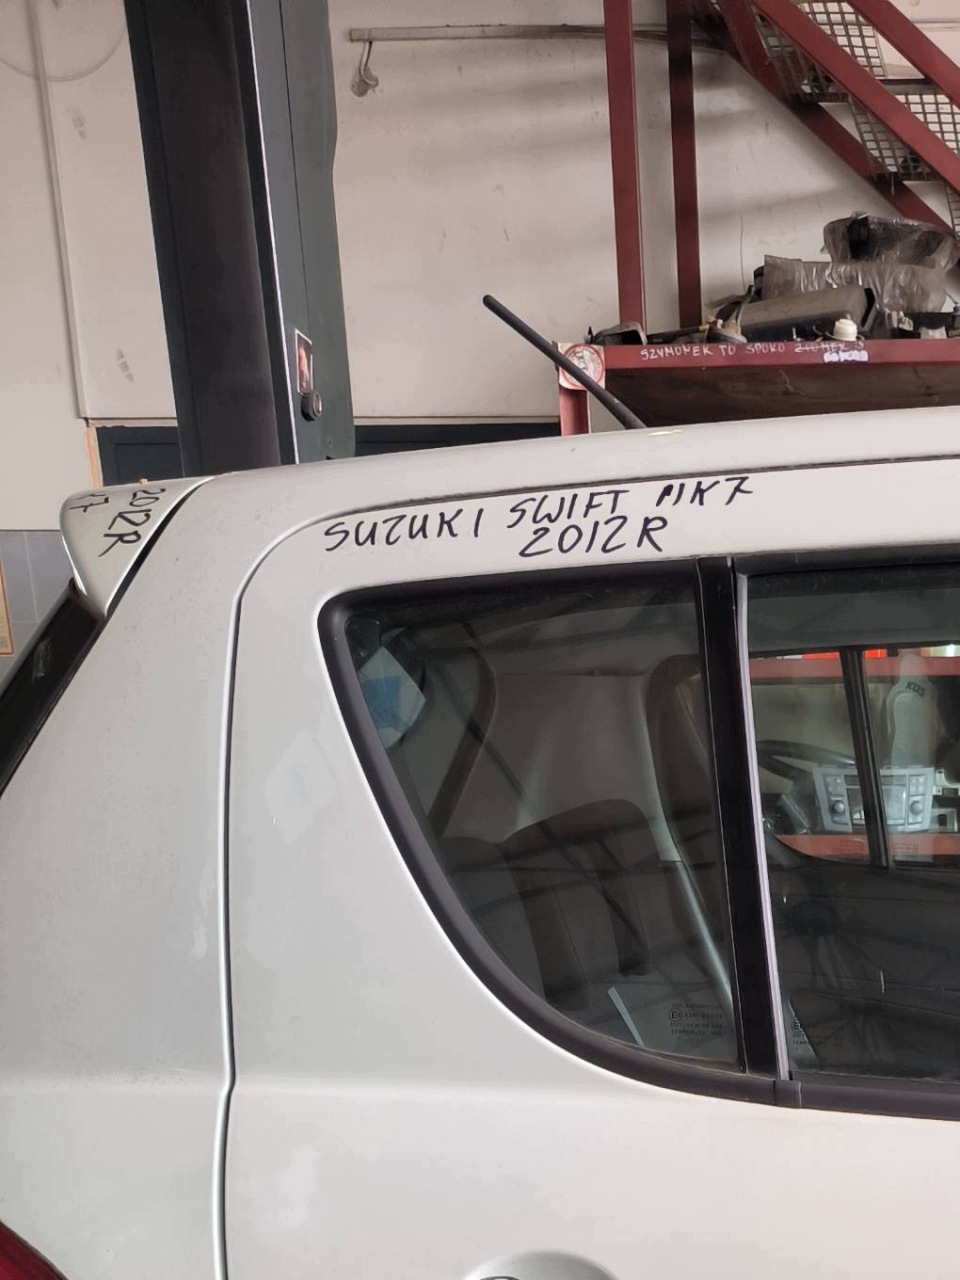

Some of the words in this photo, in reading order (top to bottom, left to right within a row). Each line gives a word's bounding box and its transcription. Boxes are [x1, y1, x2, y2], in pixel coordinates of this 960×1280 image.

[718, 346, 737, 357] TO
[324, 508, 485, 552] SUZUKI
[506, 489, 631, 530] SWIFT
